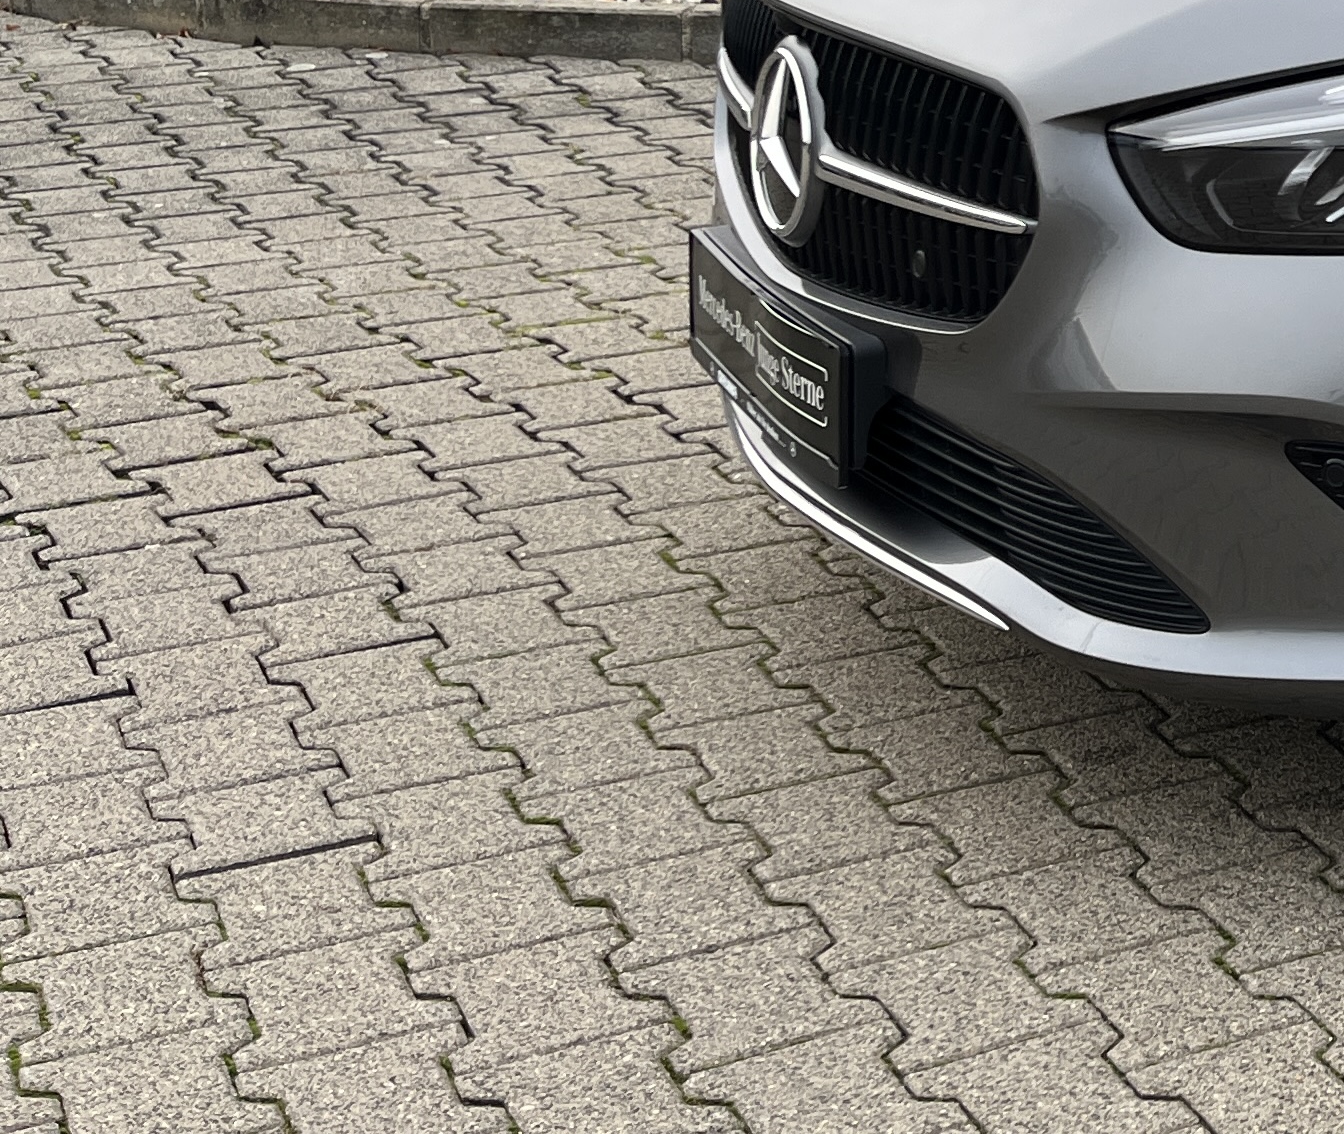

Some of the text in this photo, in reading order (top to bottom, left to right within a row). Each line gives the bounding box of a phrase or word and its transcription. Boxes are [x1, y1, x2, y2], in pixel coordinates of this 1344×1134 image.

[699, 275, 755, 357] Mercedes-Benz
[757, 331, 780, 386] Junge
[781, 356, 824, 410] Sterne
